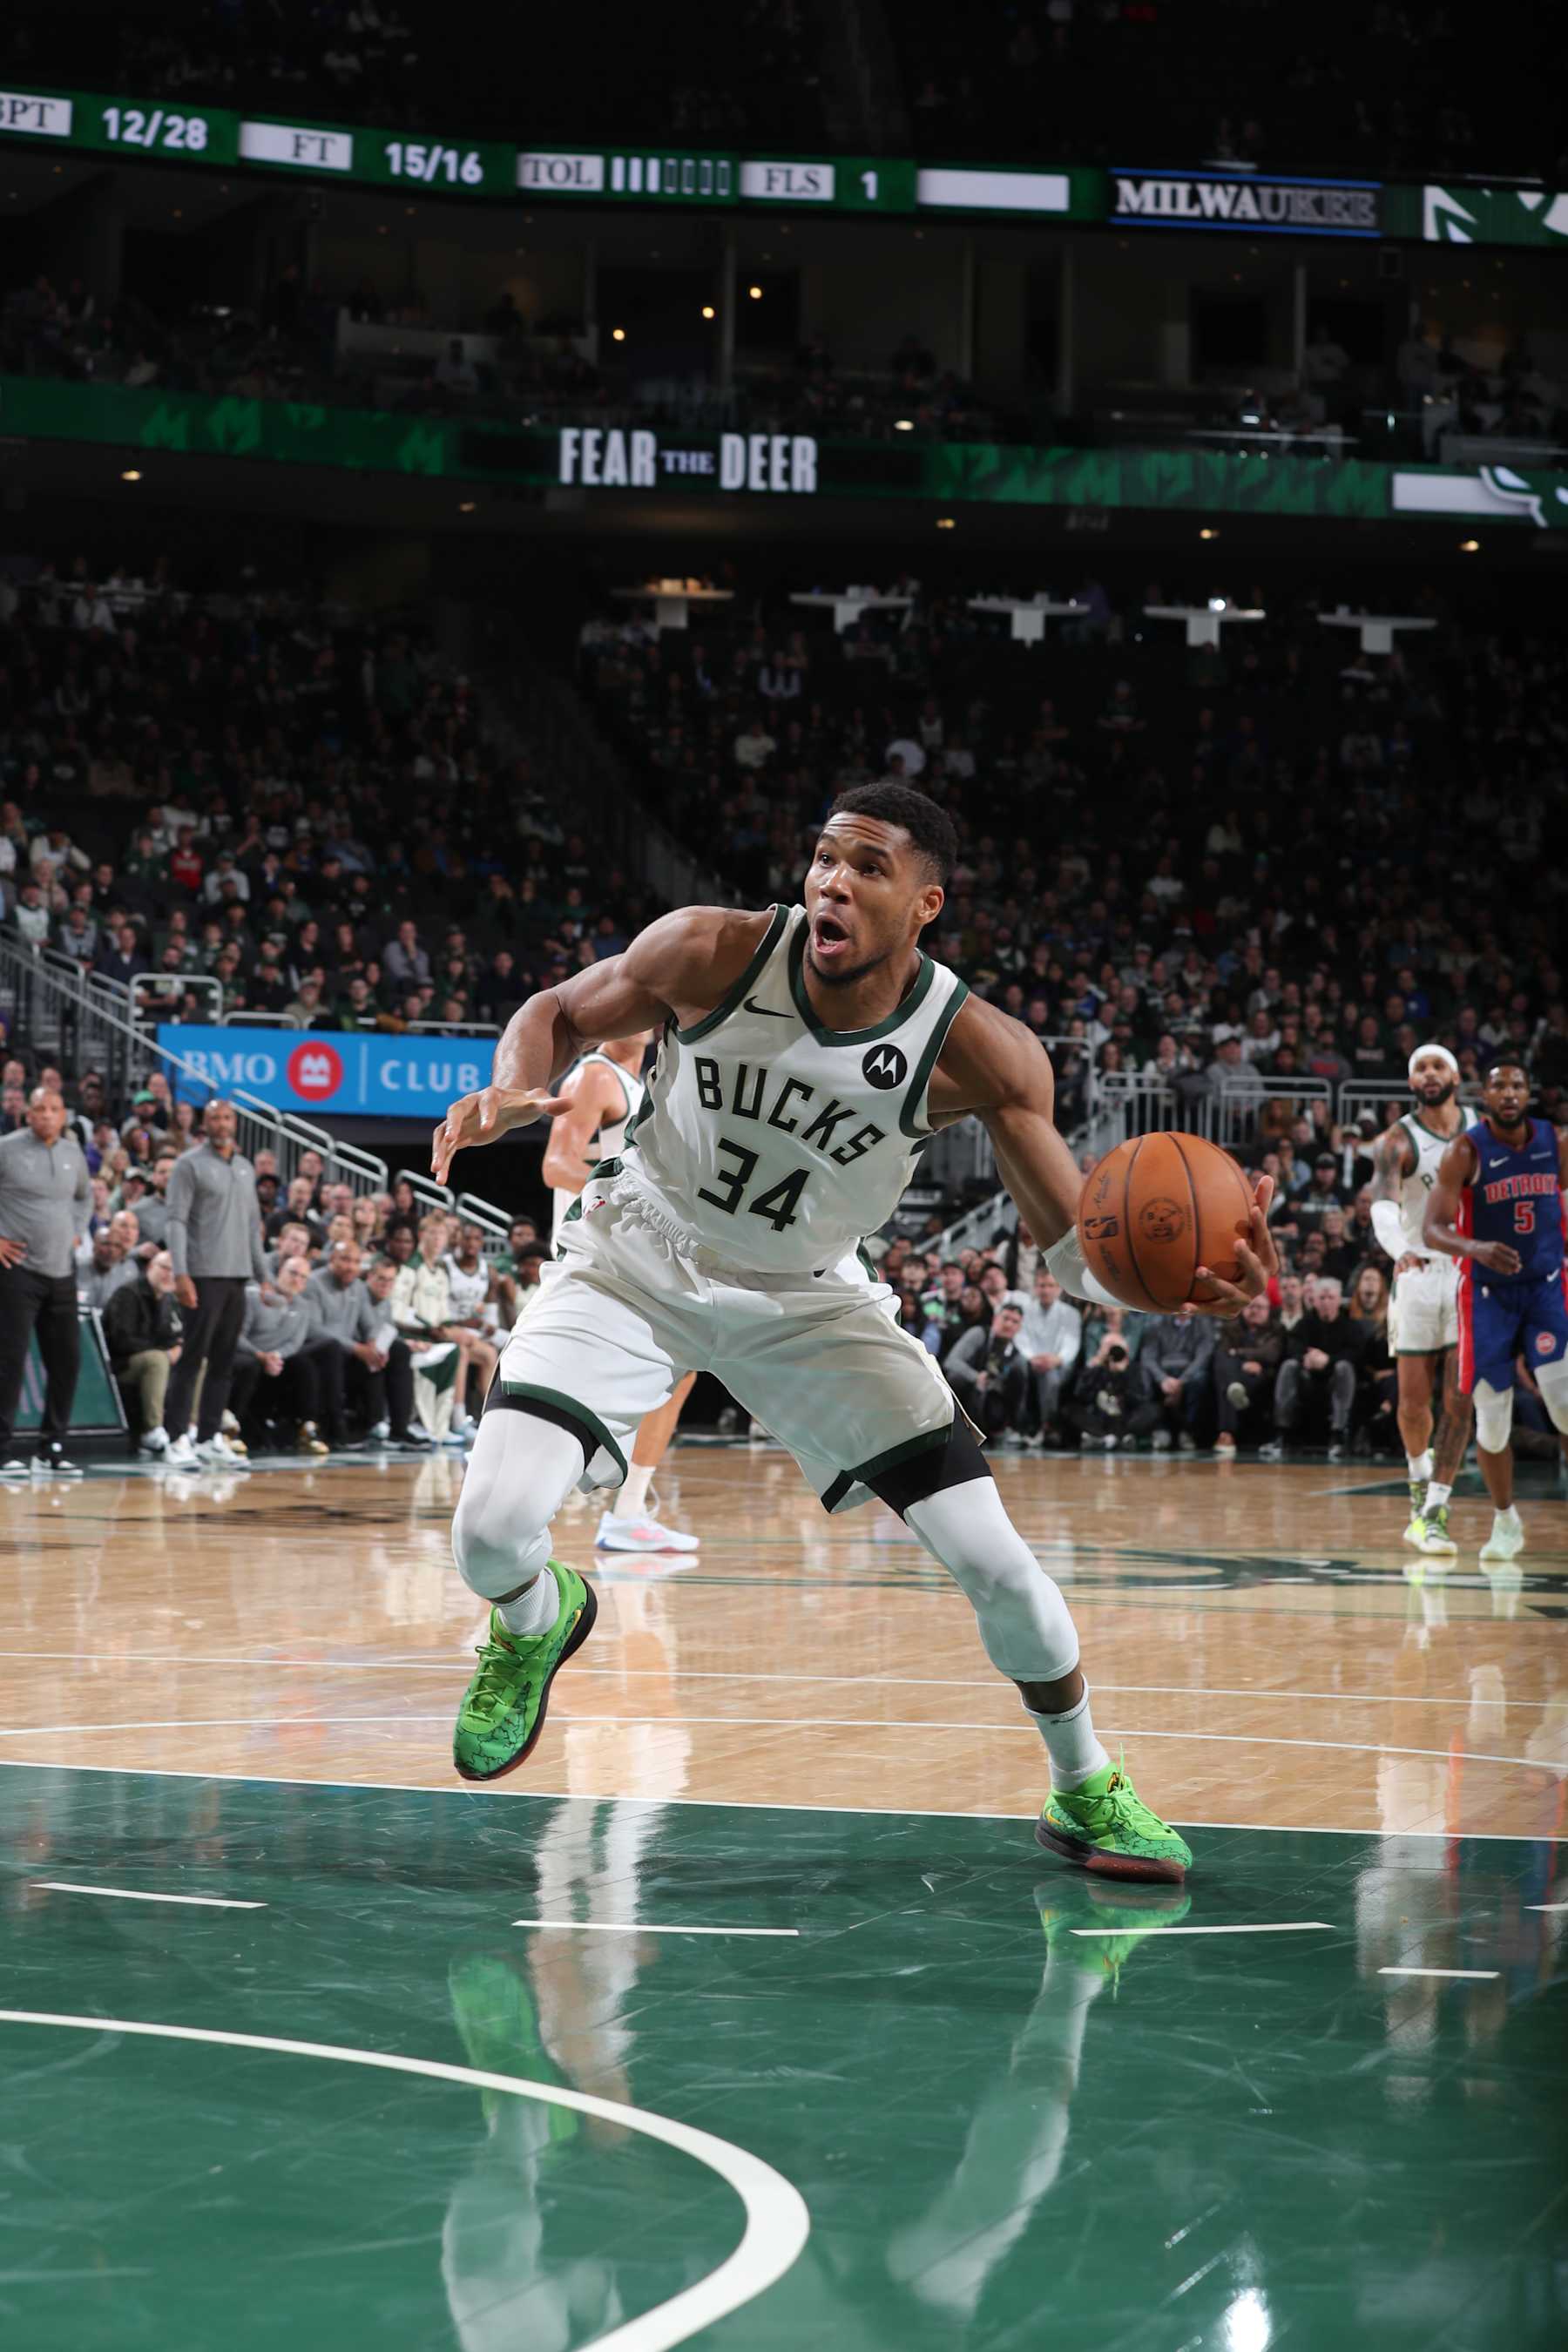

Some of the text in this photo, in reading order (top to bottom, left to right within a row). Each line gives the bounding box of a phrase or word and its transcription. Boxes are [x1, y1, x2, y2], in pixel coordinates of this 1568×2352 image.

[102, 108, 208, 149] 12/28
[292, 134, 335, 162] FT
[386, 143, 483, 183] 15/16
[524, 158, 593, 186] TOL
[764, 168, 821, 194] FLS
[862, 171, 876, 199] 1
[1116, 179, 1376, 226] MILWAUKEE
[559, 427, 817, 492] FEAR THE DEER
[182, 1050, 480, 1092] BMO CLUB
[694, 1056, 887, 1166] BUCKS
[698, 1137, 811, 1232] 34
[1484, 1173, 1557, 1204] DETROIT
[1514, 1200, 1535, 1234] 5
